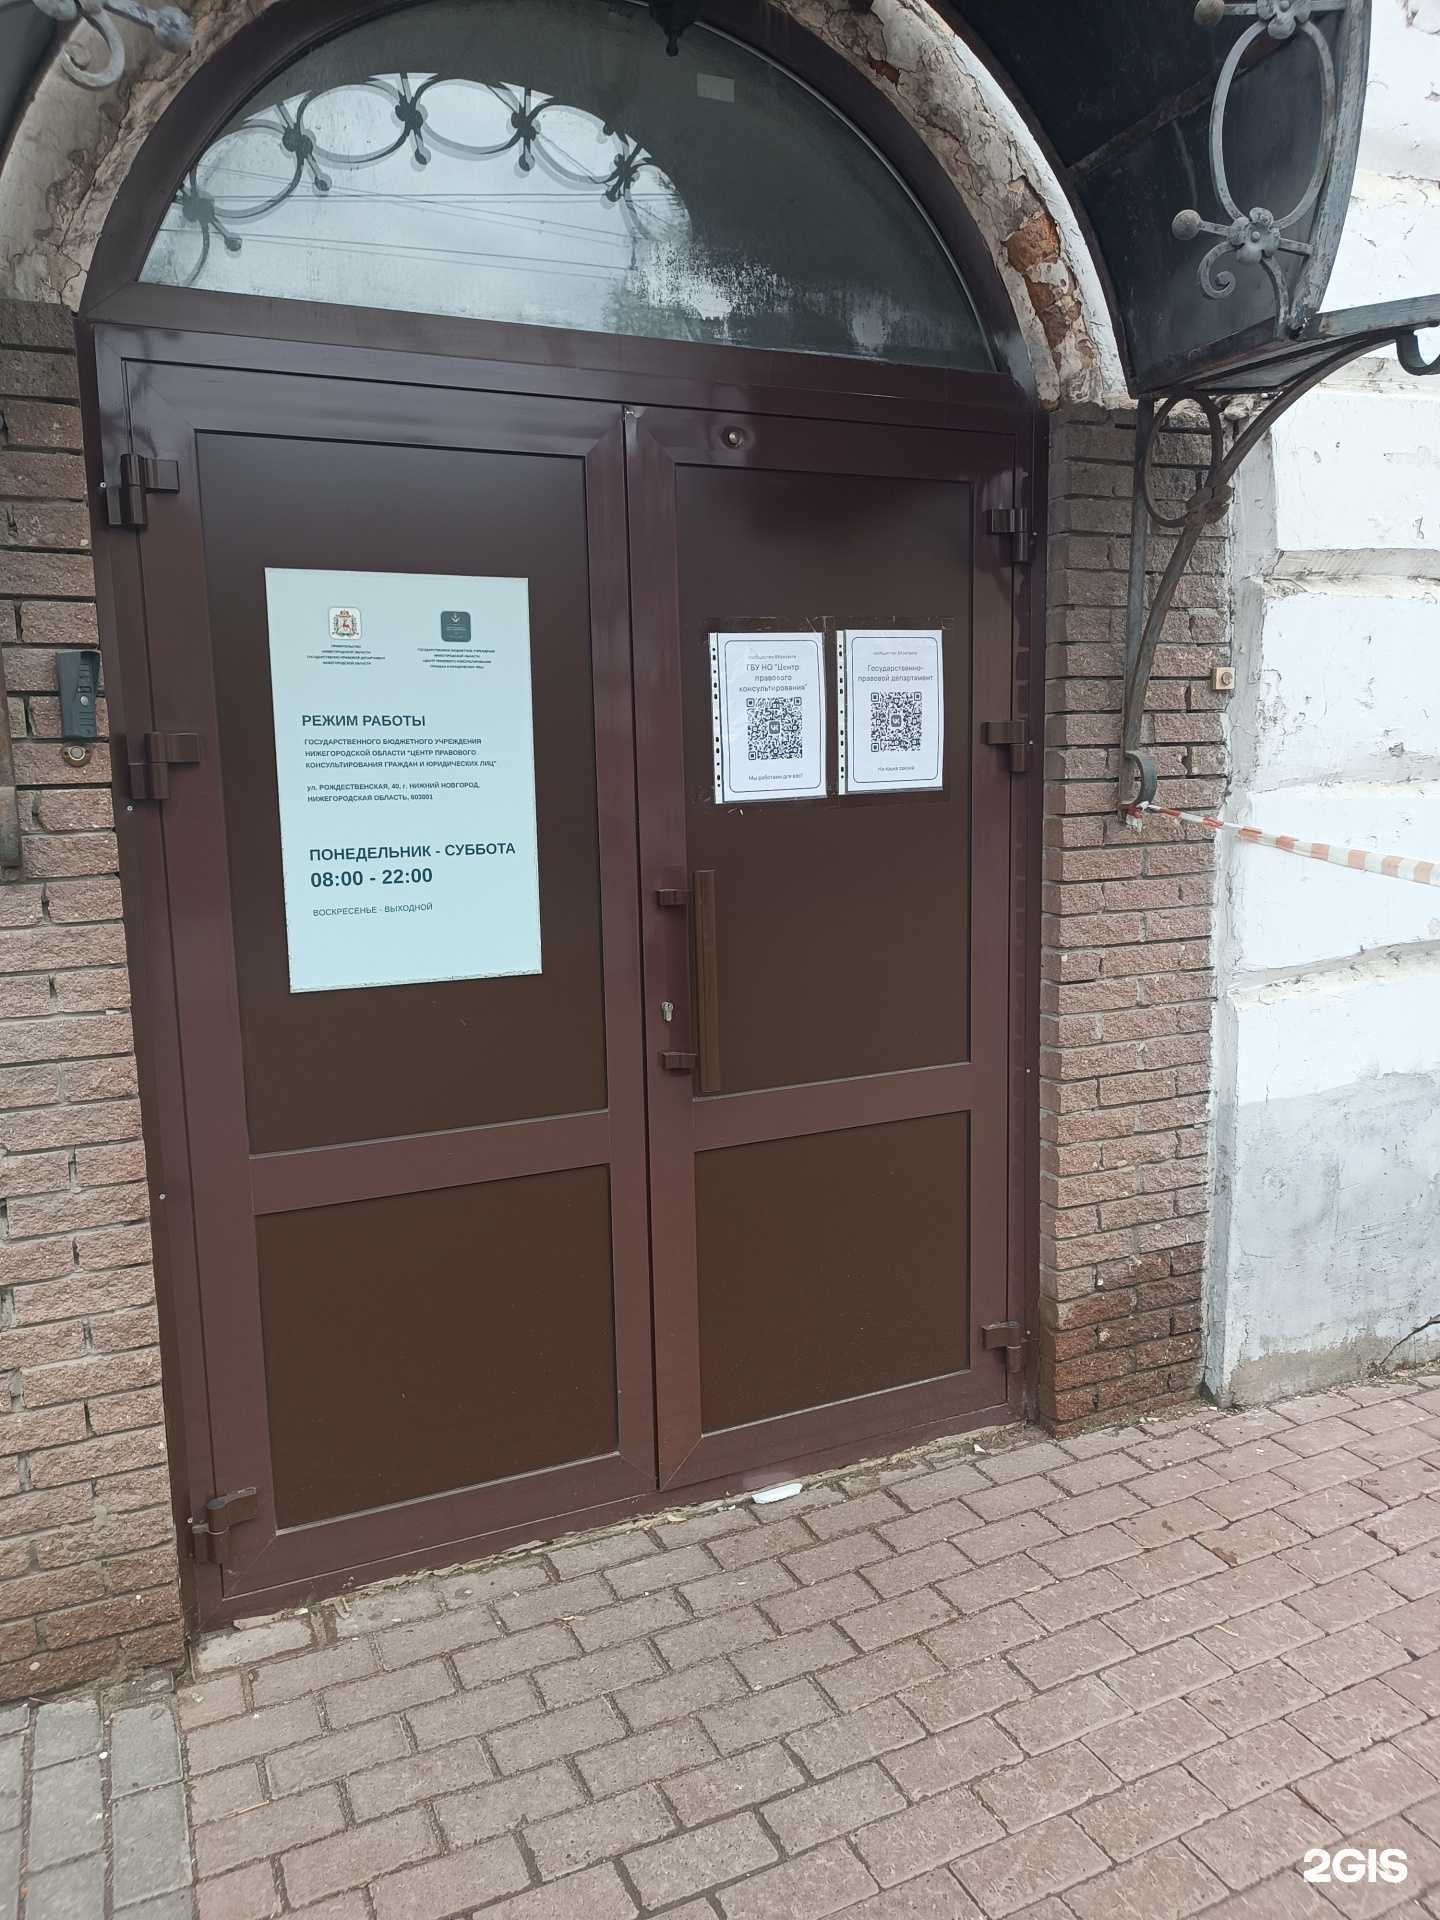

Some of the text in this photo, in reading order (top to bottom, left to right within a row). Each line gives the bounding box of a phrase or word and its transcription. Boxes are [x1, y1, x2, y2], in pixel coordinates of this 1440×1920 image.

[857, 674, 933, 682] правовой департамент
[302, 715, 426, 726] РЕЖИМ РАБОТЫ
[304, 738, 381, 746] ГОСУДАРСТВЕННОГО
[305, 749, 371, 757] НИЖЕГОРОДСКОЙ
[407, 749, 433, 757] "ЦЕНТР
[426, 760, 479, 768] ЮРИДИЧЕСКИХ
[319, 783, 390, 791] РОЖДЕСТВЕНСКАЯ,
[409, 781, 439, 789] НИЖНИЙ
[307, 794, 373, 802] НИЖЕГОРОДСКАЯ
[309, 845, 432, 863] ПОНЕДЕЛЬНИК
[444, 842, 516, 856] СУББОТА
[310, 871, 363, 887] 08:00
[381, 867, 433, 885] 22:00
[313, 906, 377, 917] ВОСКРЕСЕНЬЕ
[384, 902, 433, 913] ВЫХОДНОЙ
